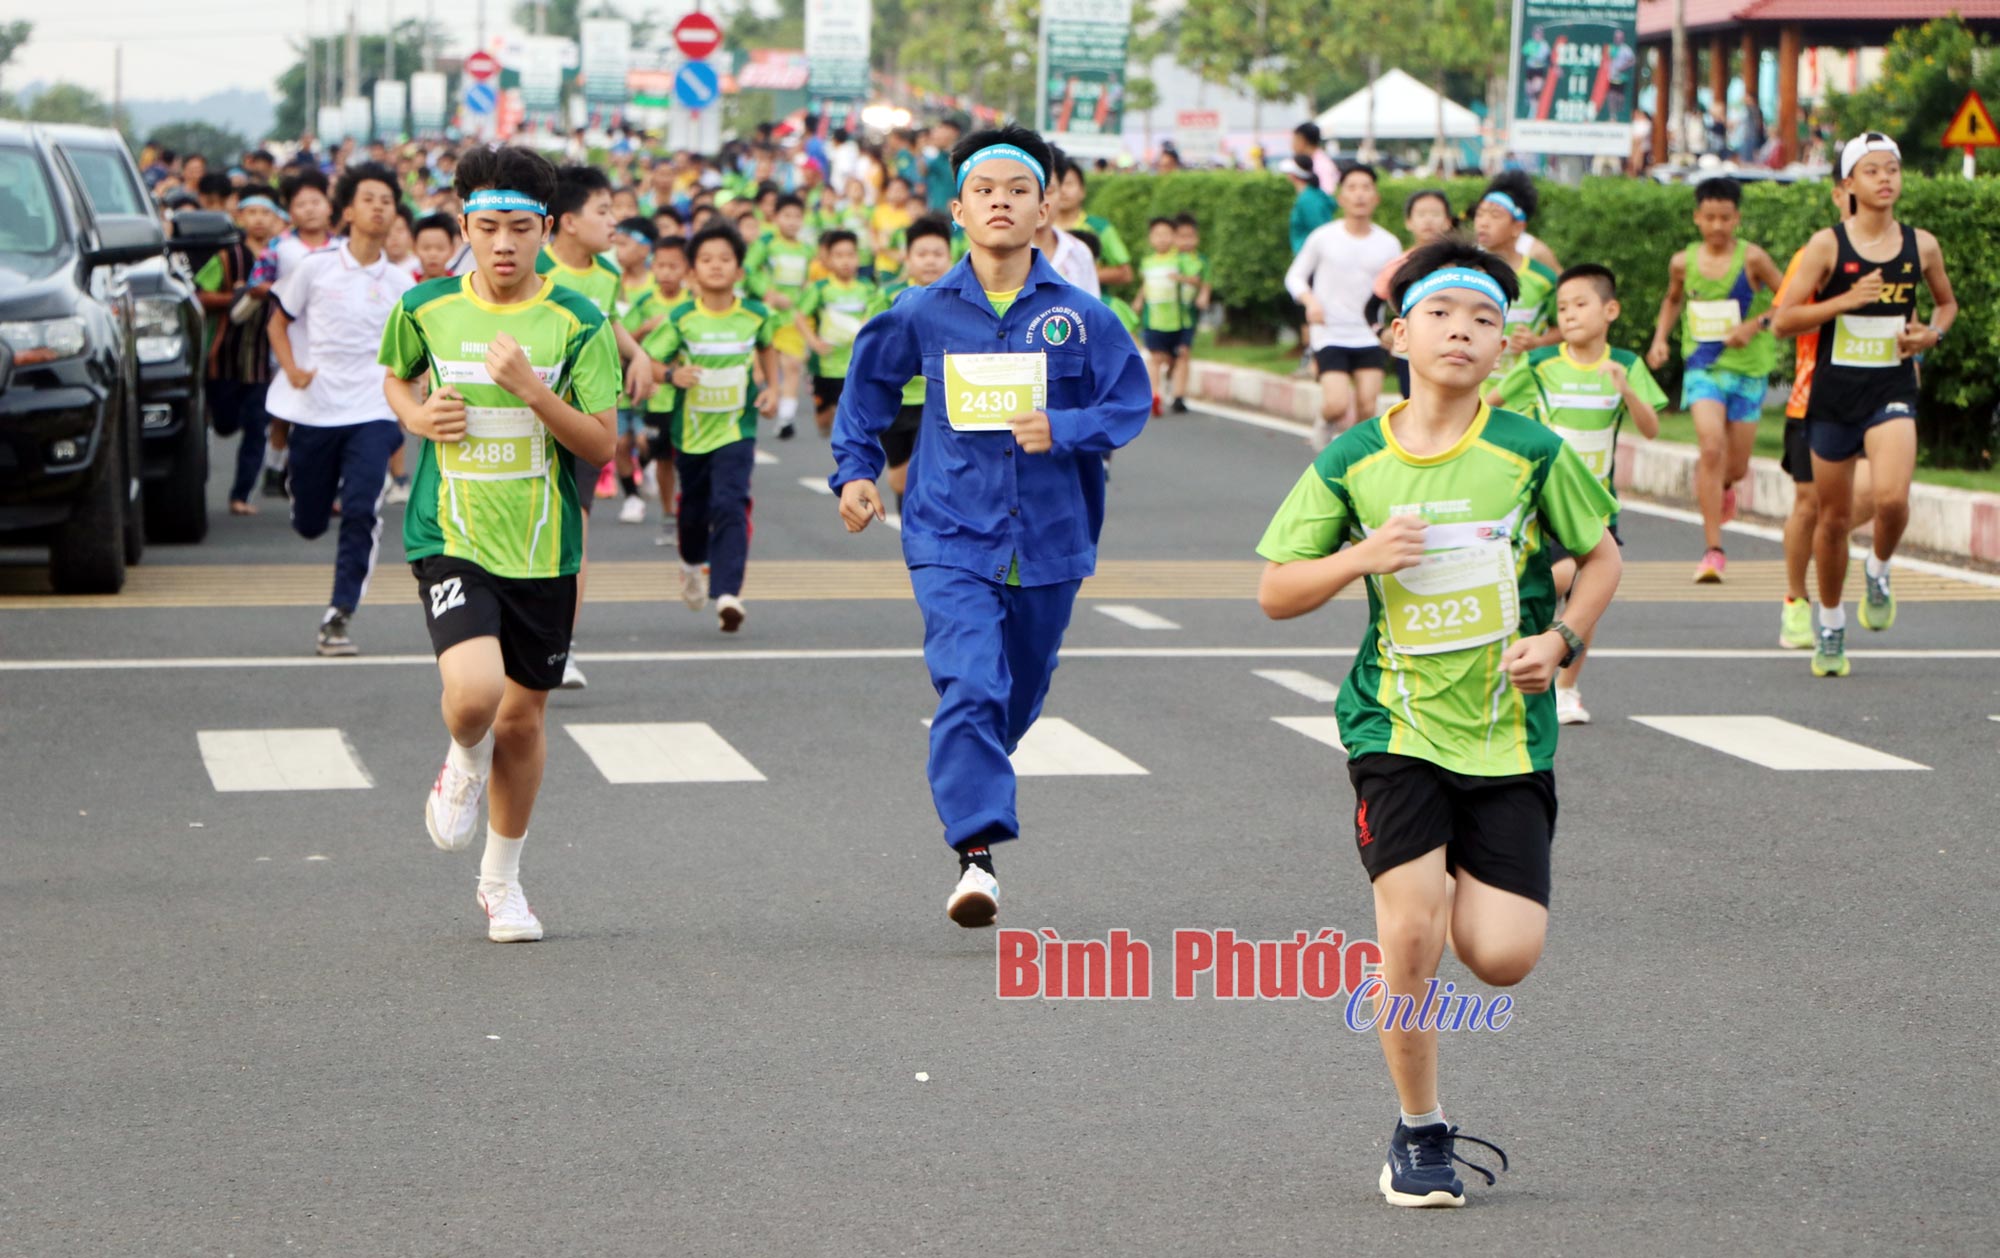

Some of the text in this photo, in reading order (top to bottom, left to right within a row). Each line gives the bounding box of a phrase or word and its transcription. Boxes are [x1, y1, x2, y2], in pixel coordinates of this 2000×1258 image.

[1844, 339, 1886, 356] 2413
[960, 390, 1018, 413] 2430
[458, 440, 516, 464] 2488
[429, 576, 467, 620] 22
[1403, 595, 1482, 632] 2323
